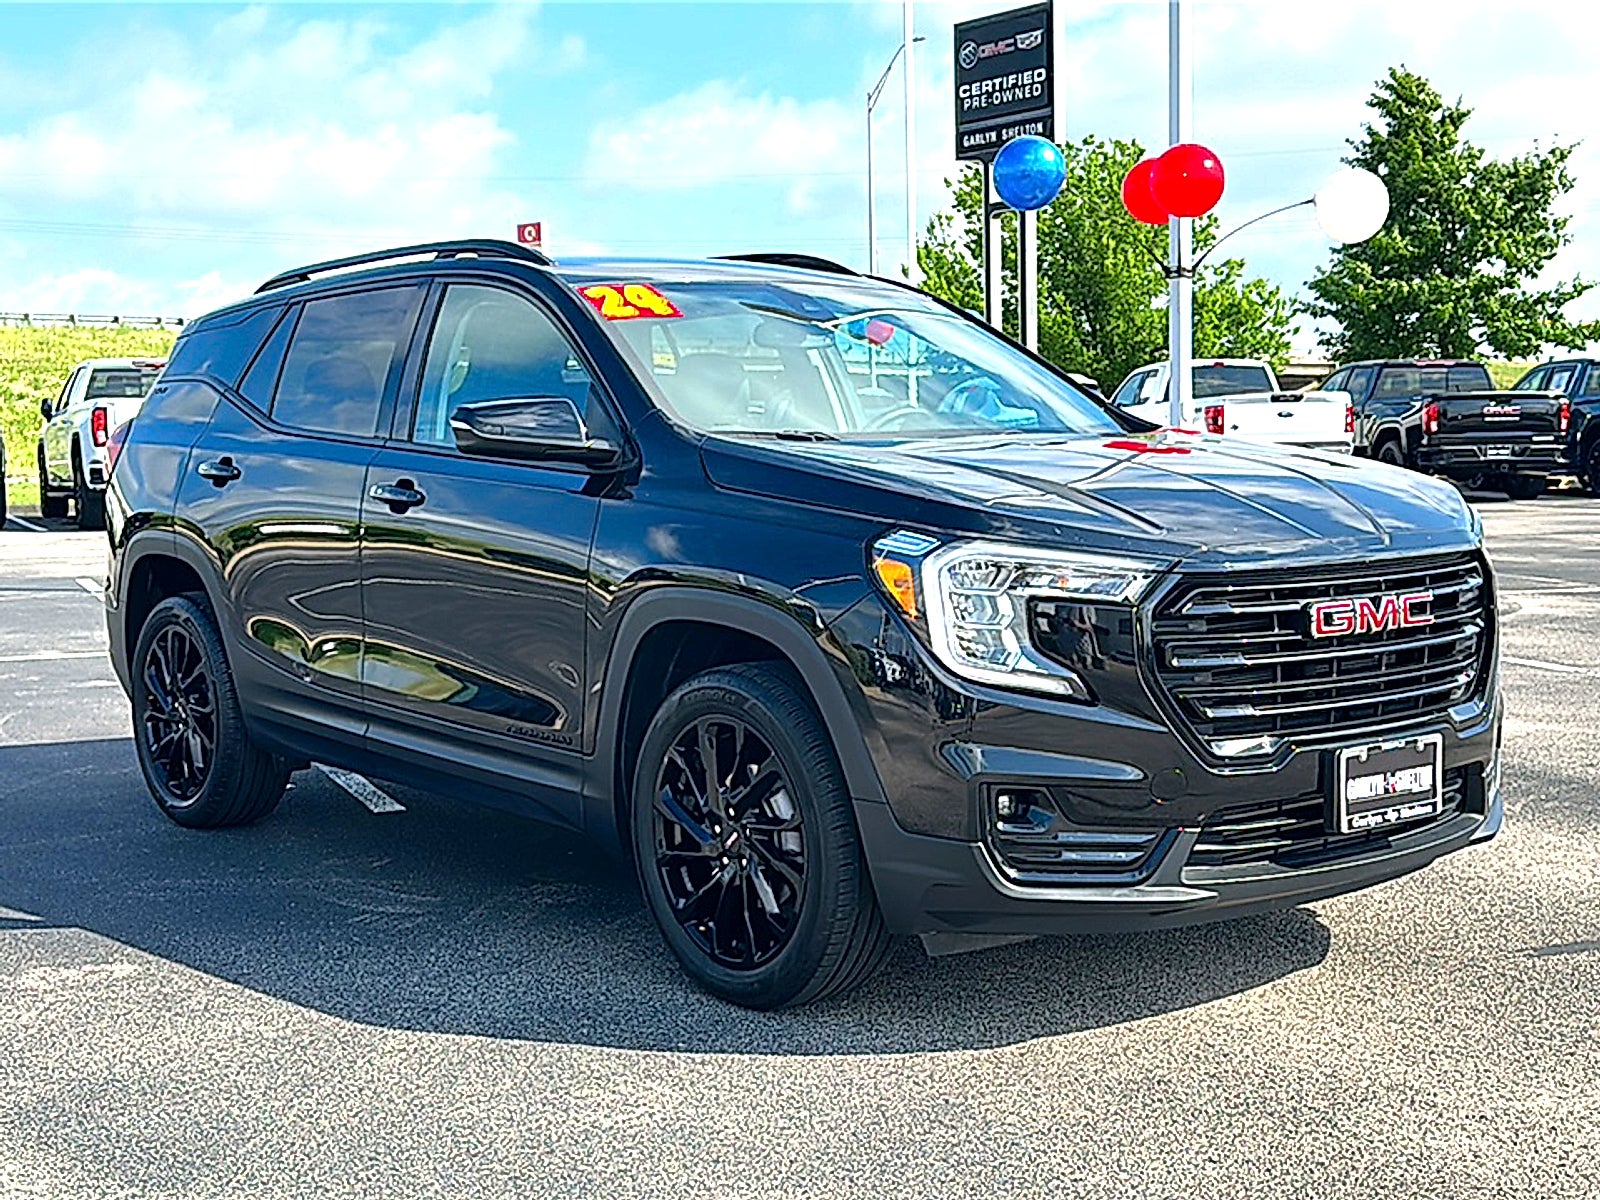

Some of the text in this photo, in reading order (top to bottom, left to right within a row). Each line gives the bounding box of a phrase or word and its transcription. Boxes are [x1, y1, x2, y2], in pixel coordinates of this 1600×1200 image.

[979, 38, 1015, 58] GMC
[959, 68, 1047, 98] CERTIFIED
[963, 83, 1042, 111] PRE-OWNED
[963, 122, 1044, 148] GARLYN SHELTON
[1483, 405, 1521, 415] GMC
[1311, 591, 1436, 638] GMC
